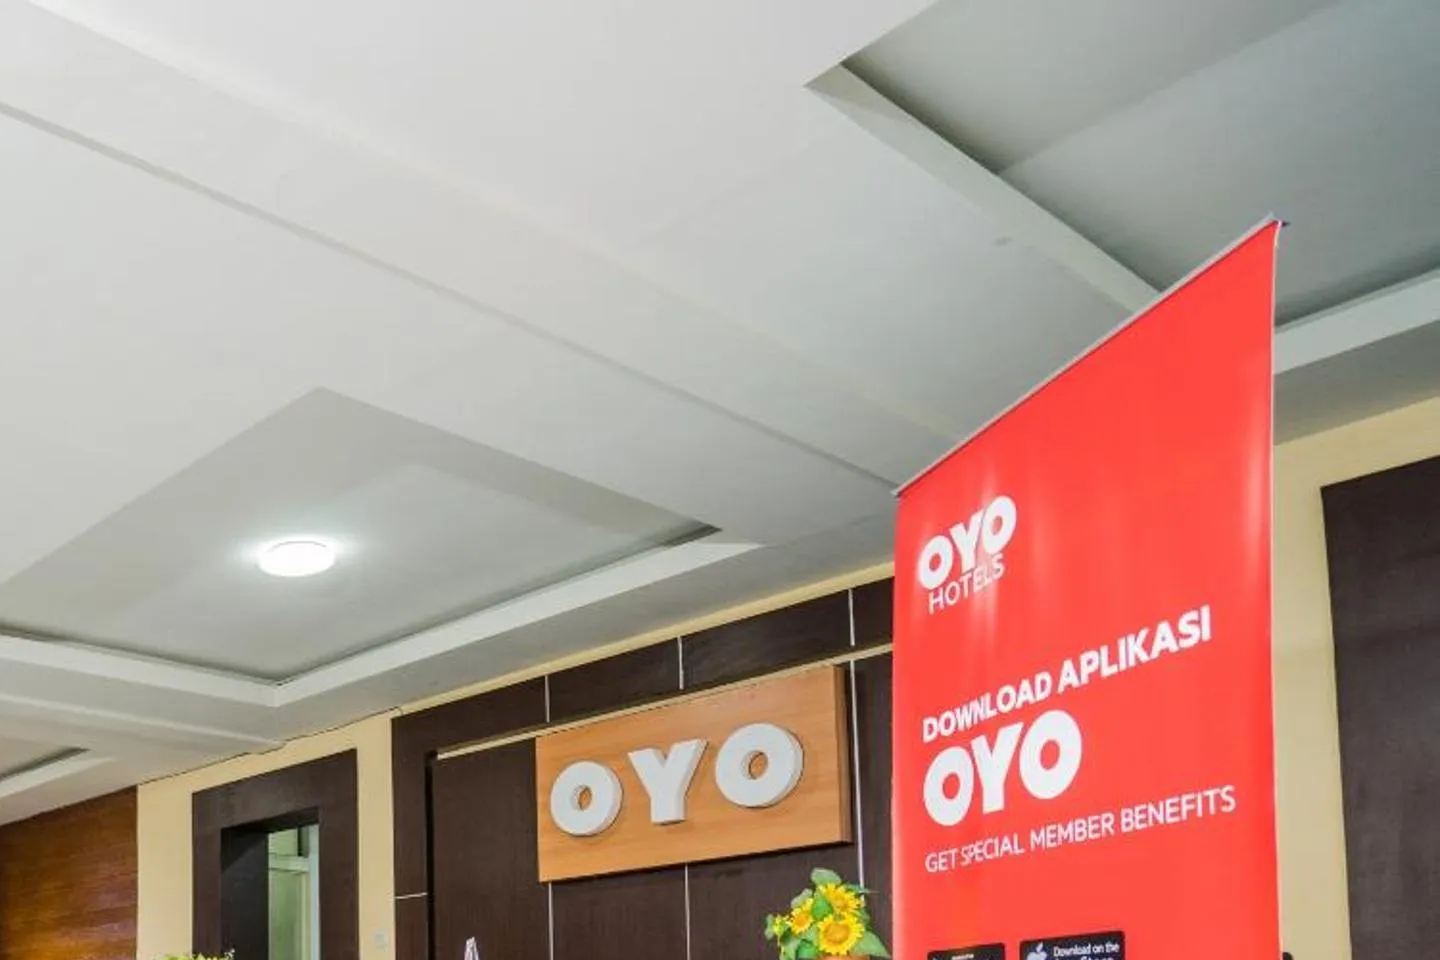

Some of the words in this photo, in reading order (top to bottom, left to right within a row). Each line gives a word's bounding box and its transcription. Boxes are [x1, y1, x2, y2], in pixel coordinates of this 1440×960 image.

[917, 496, 1017, 589] OYO
[928, 553, 1005, 614] HOTELS
[922, 671, 1052, 743] DOWNLOAD
[1058, 604, 1212, 693] APLIKASI
[549, 722, 804, 837] OYO
[923, 709, 1082, 826] OYO
[924, 848, 959, 873] GET
[960, 834, 1025, 867] SPECIAL
[1030, 812, 1115, 852] MEMBER
[1120, 785, 1236, 832] BENEFITS
[1053, 943, 1091, 957] Download
[1092, 944, 1104, 954] on
[1105, 941, 1120, 953] the
